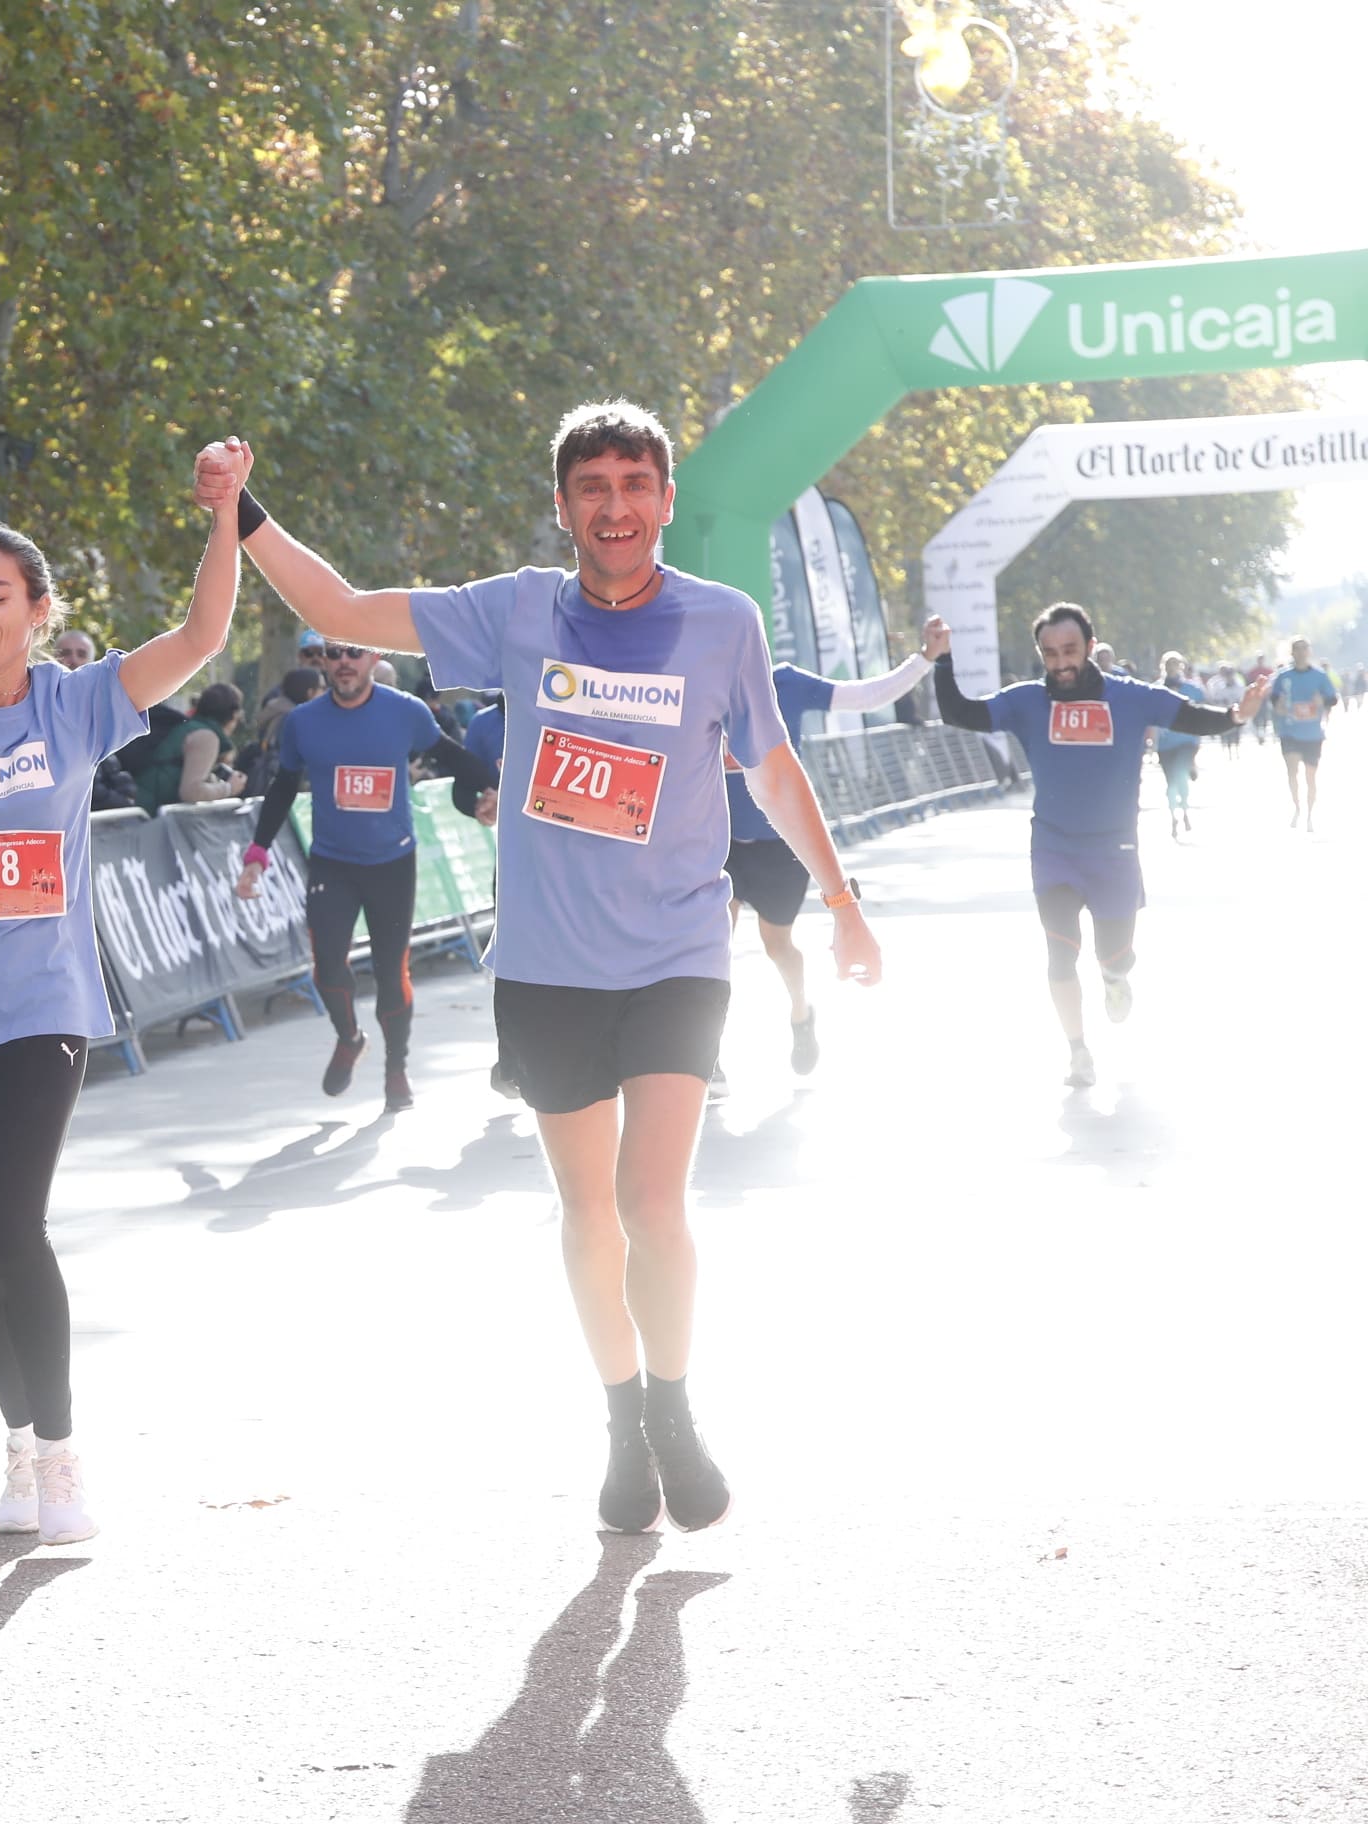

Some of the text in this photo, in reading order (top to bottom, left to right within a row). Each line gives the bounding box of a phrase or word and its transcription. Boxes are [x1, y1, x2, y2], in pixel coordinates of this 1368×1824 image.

[1068, 286, 1337, 359] Unicaja
[1076, 443, 1115, 479] El
[1123, 442, 1206, 477] Norte
[1212, 441, 1244, 471] de
[582, 679, 681, 707] ILUNION
[1060, 708, 1089, 729] 161
[343, 775, 374, 795] 159
[550, 749, 612, 799] 720
